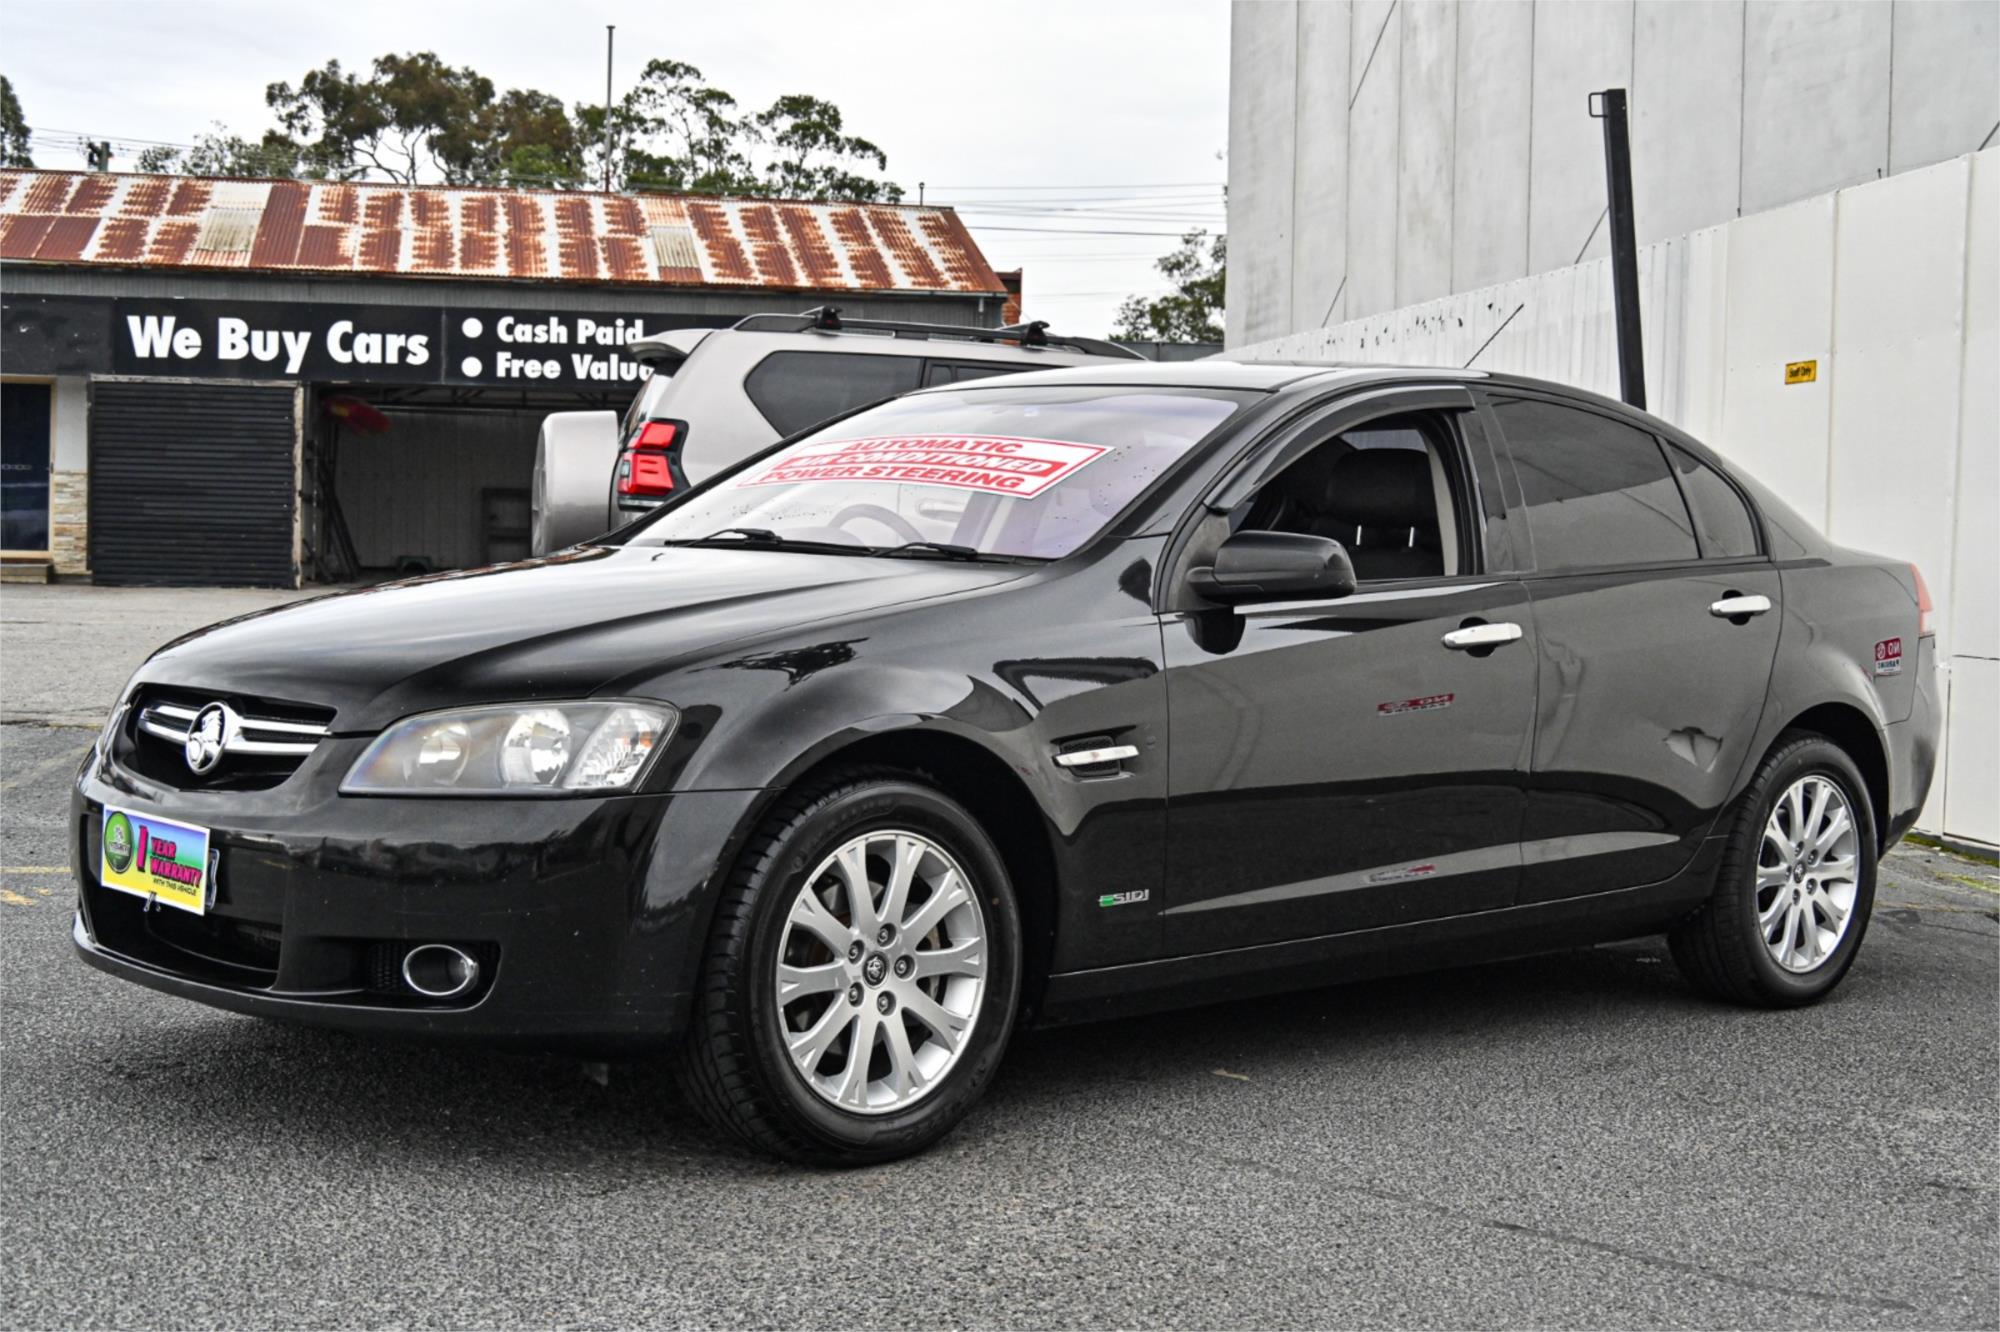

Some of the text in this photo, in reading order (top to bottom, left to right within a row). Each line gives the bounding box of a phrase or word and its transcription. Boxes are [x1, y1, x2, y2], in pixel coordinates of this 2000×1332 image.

[497, 316, 644, 345] Cash Paid
[127, 316, 429, 373] We Buy Cars
[497, 352, 561, 379] Free
[841, 439, 1023, 454] AUTOMATIC
[835, 451, 1048, 475] CONDITIONED
[760, 466, 1025, 489] POWER STEERING
[136, 825, 149, 873] 1
[151, 837, 177, 859] YEAR
[150, 857, 203, 888] WARRANTY
